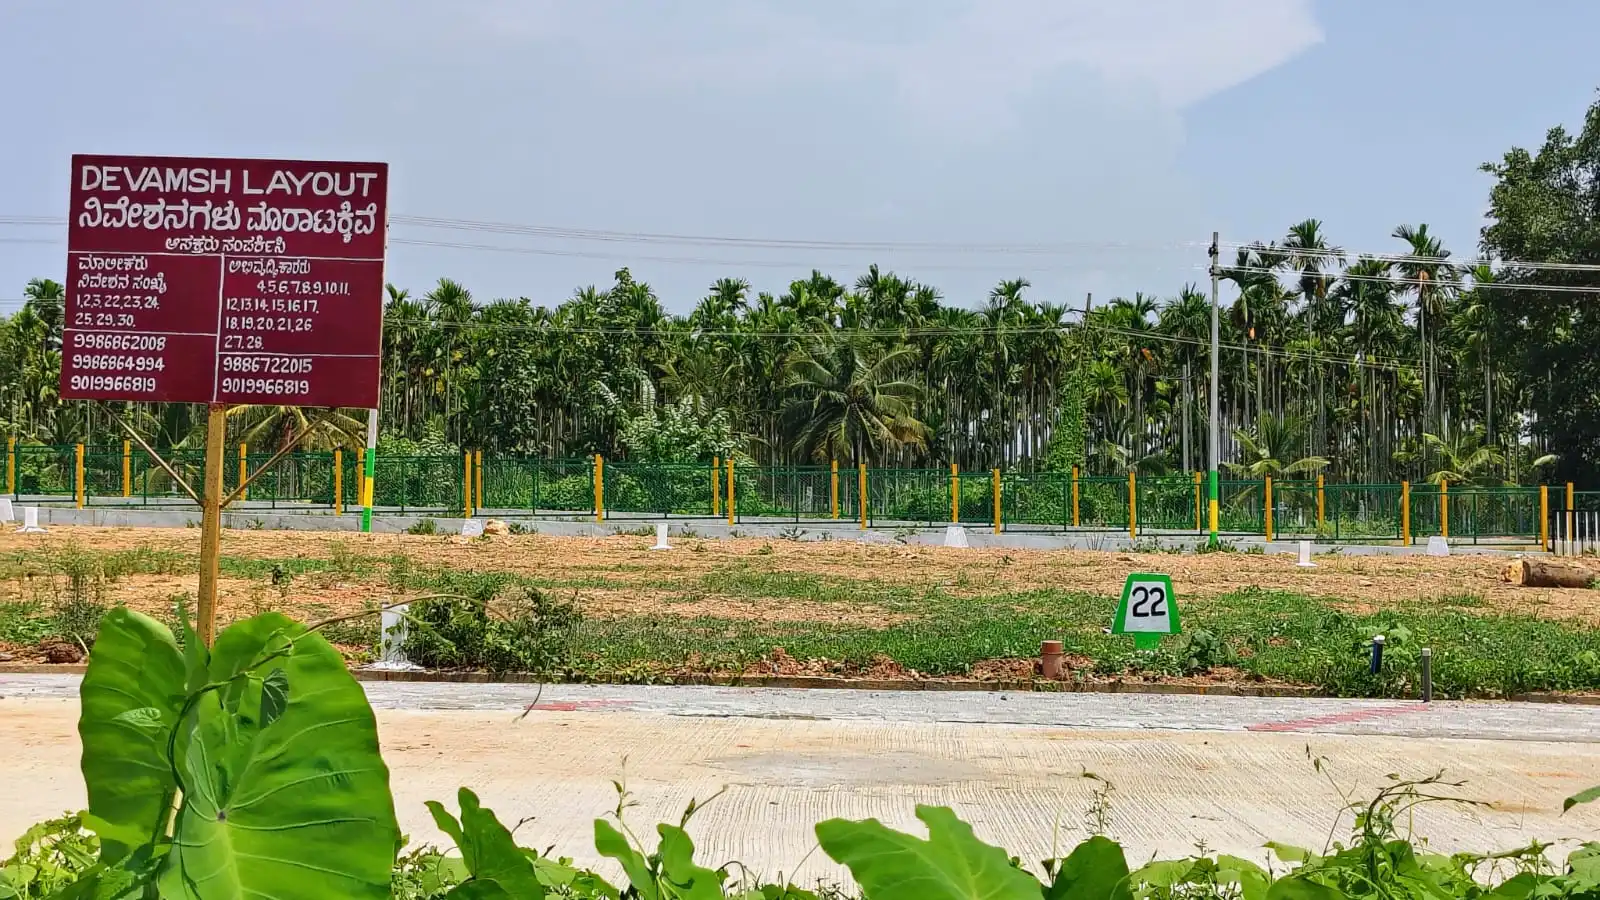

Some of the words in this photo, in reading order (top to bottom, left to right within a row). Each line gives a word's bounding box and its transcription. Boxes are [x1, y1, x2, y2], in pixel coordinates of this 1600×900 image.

[80, 165, 231, 194] DEVAMSH
[242, 170, 378, 196] LAYOUT
[78, 196, 241, 232] ನಿವೇಶನಗಳು
[165, 235, 220, 253] ಆಸಕ್ತರು
[222, 235, 286, 254] ಸಂಪರ್ಕಿಸಿ
[78, 254, 148, 271] ಮಾಲೀಕರು
[77, 272, 130, 289] ನಿವೇಶನ
[73, 333, 167, 351] 9986862008
[72, 354, 165, 372] 9986864994
[223, 357, 313, 374] 9886722015
[70, 375, 156, 392] 9019966819
[222, 378, 310, 395] 9019966819
[1132, 586, 1166, 617] 22
